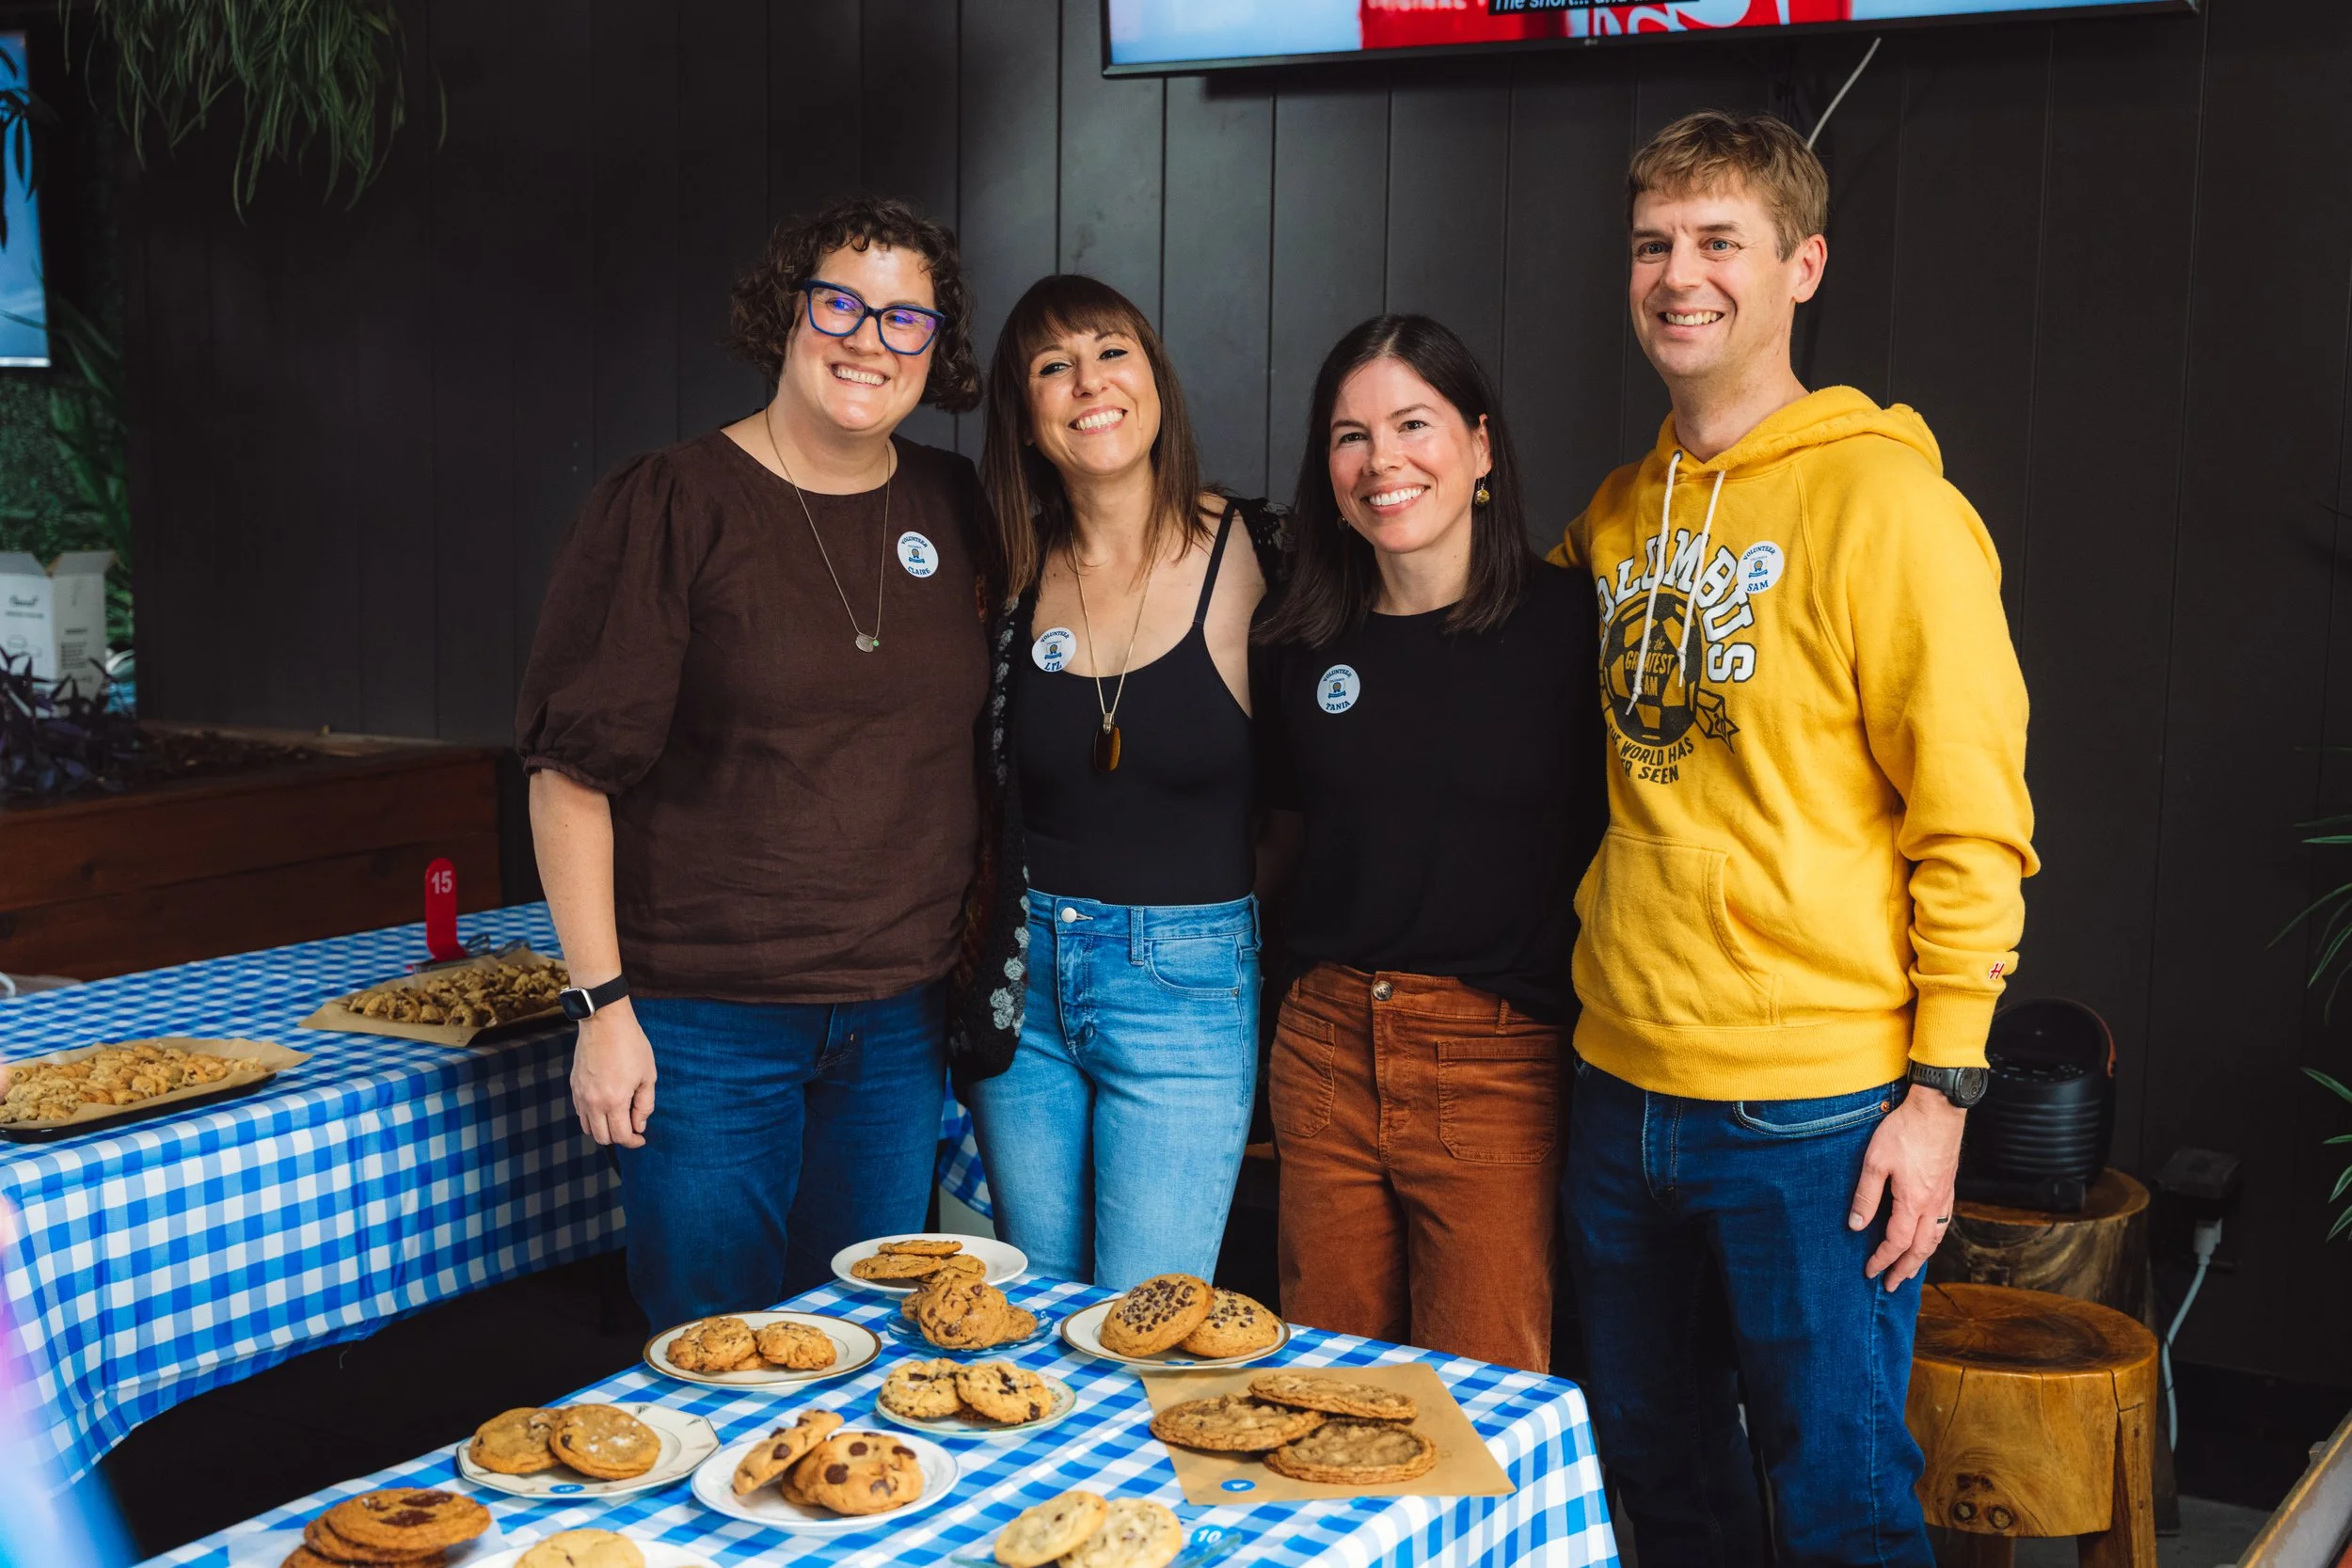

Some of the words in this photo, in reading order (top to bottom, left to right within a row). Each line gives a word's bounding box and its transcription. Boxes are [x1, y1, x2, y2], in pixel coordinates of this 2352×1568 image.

[901, 536, 929, 548] VOLUNTEER
[1742, 546, 1776, 561] VOLUNTEER
[907, 566, 931, 576] CLAIRE
[1746, 579, 1770, 592] SAM
[1597, 528, 1757, 684] OLUMBUS
[1040, 630, 1071, 643] VOLUNTEER
[1044, 660, 1062, 671] LIZ
[1625, 650, 1675, 675] GRATEST
[1322, 668, 1353, 682] VOLUNTEER
[1325, 701, 1352, 711] TANIA
[1620, 740, 1664, 766] WORLD
[1668, 736, 1694, 764] HAS
[1638, 765, 1679, 785] SEEN
[431, 870, 453, 895] 15
[1198, 1528, 1222, 1544] 10
